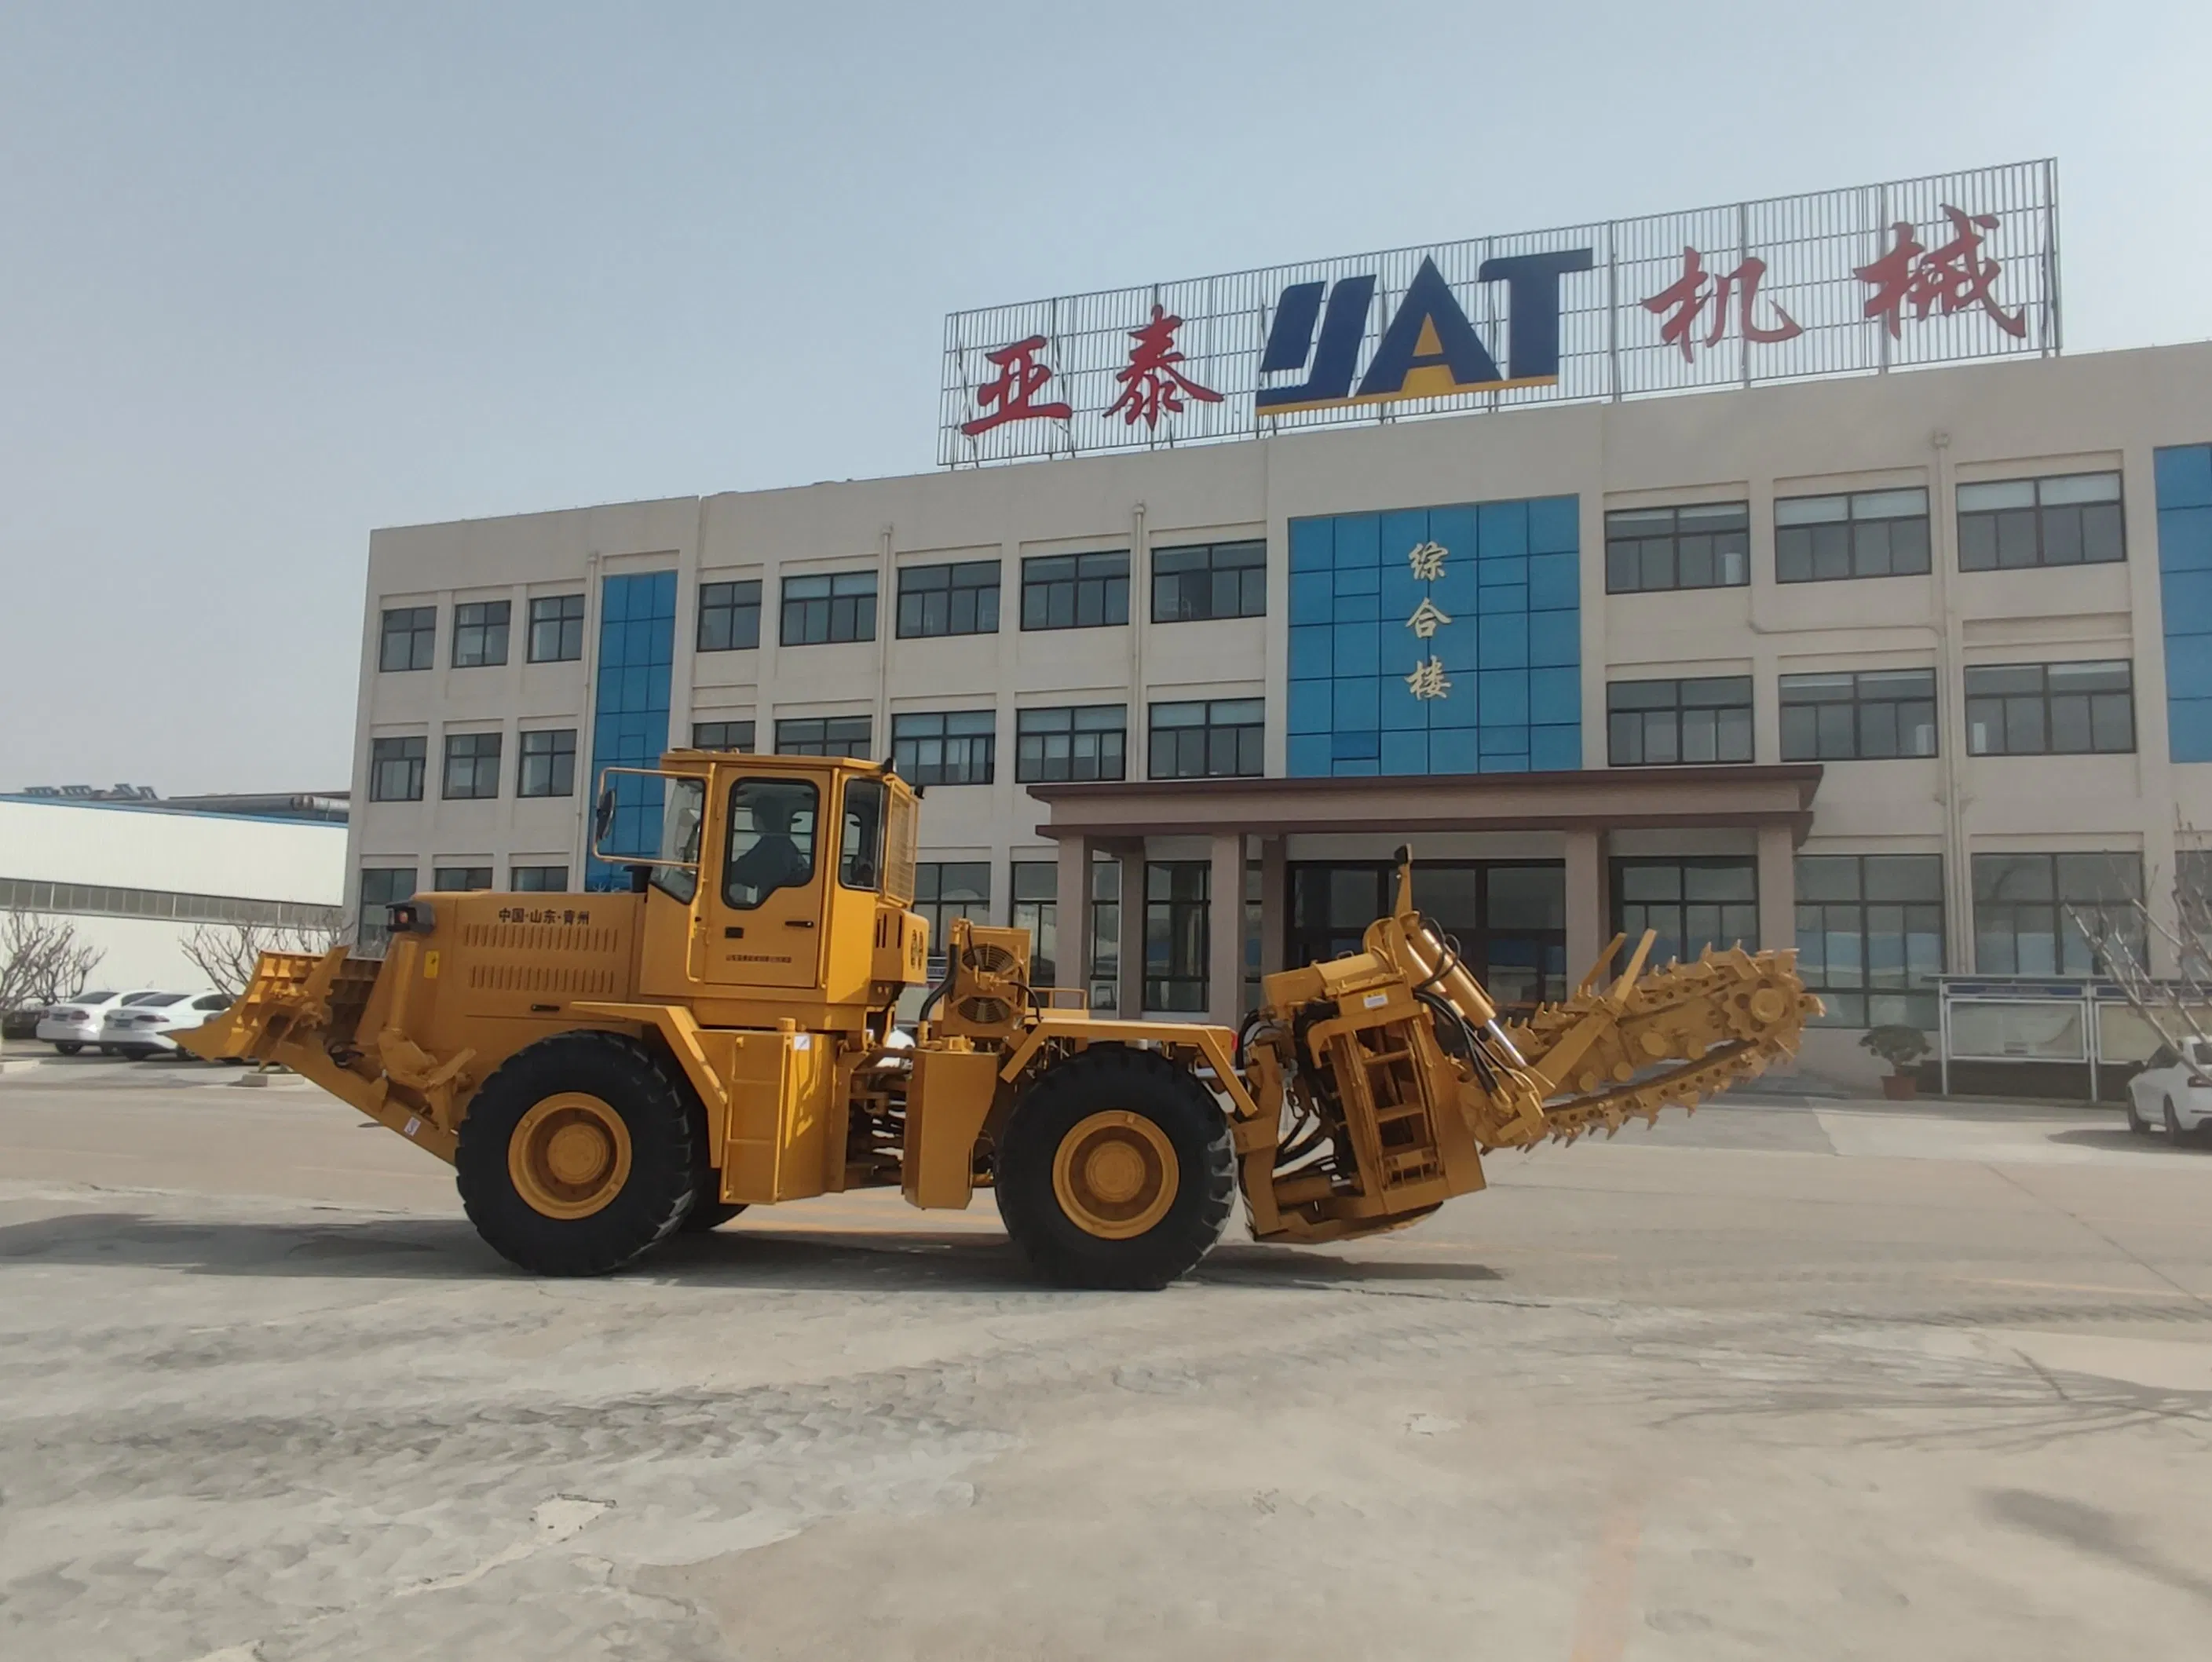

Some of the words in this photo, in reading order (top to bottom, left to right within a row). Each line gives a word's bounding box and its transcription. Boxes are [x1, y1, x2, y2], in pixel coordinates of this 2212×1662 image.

[960, 304, 1225, 437] 亚泰
[1640, 203, 2026, 364] 机械
[1405, 541, 1453, 700] 综合楼
